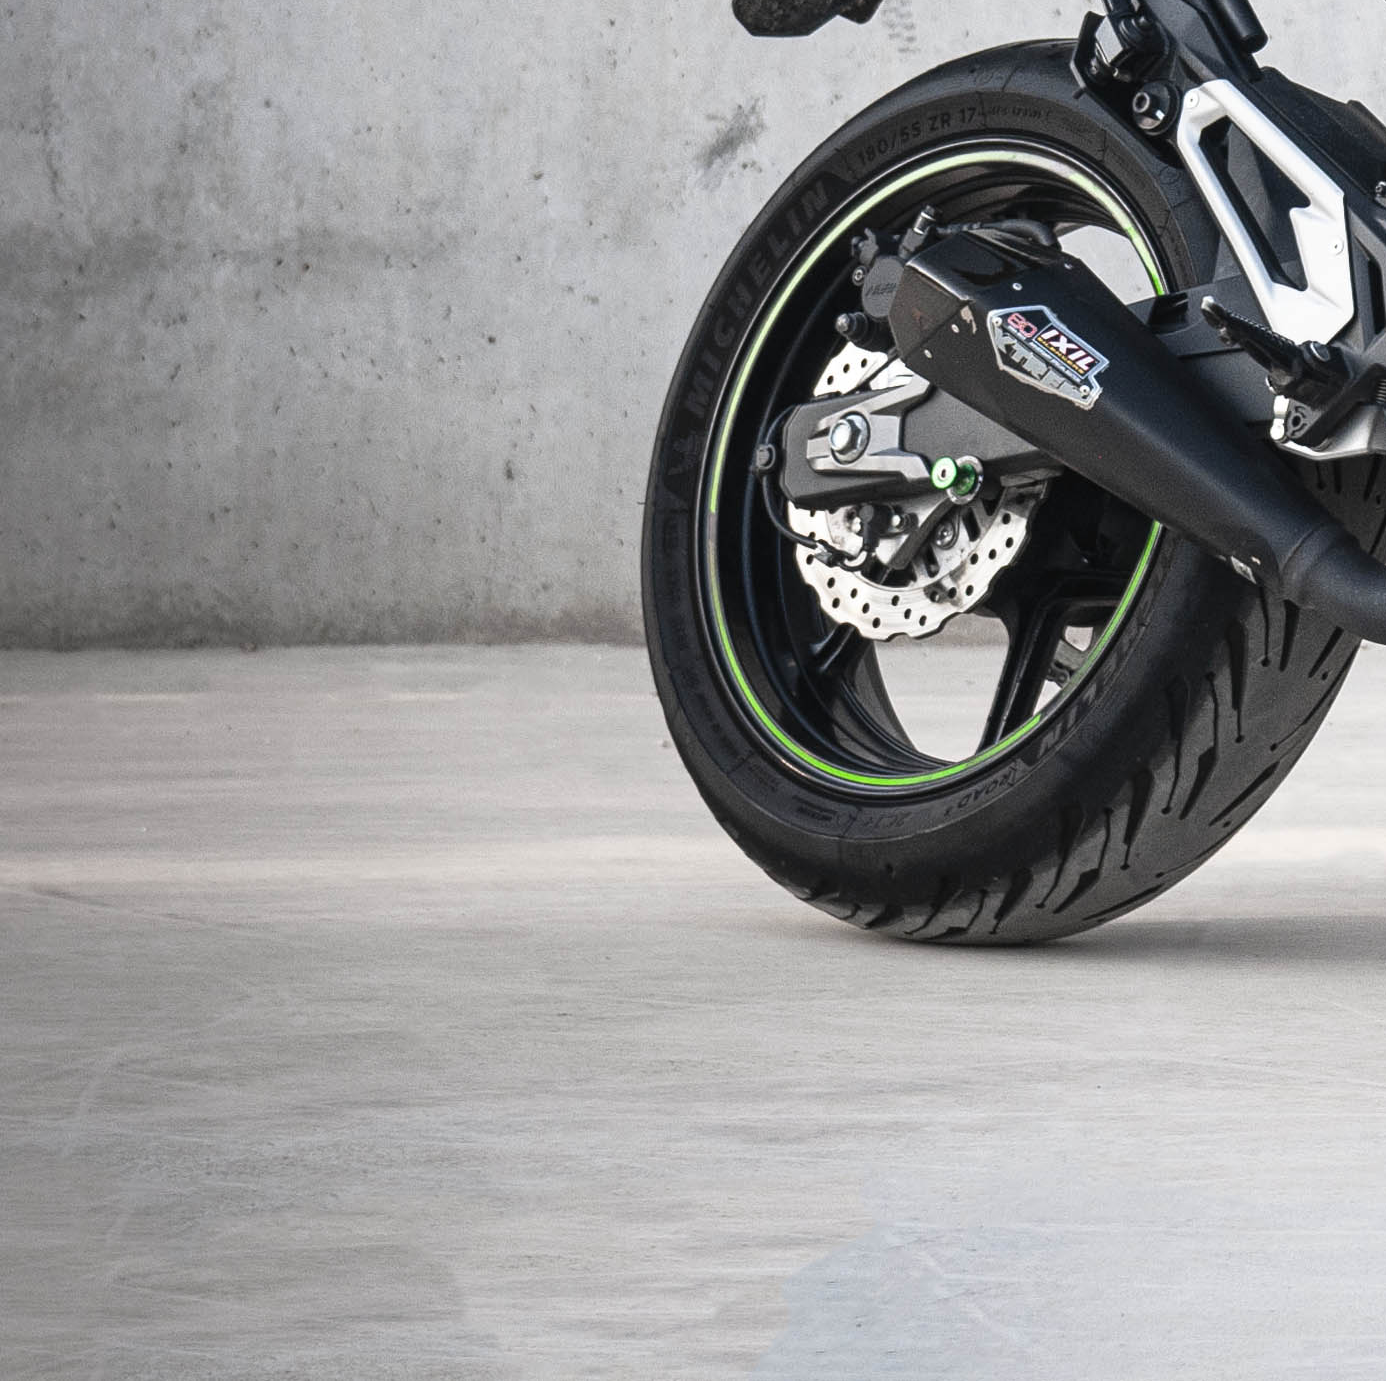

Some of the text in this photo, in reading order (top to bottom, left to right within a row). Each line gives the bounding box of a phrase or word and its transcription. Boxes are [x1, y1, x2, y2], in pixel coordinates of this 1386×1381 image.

[928, 113, 952, 132] ZR
[686, 179, 830, 416] MICHELIN
[1040, 328, 1095, 371] IXIL
